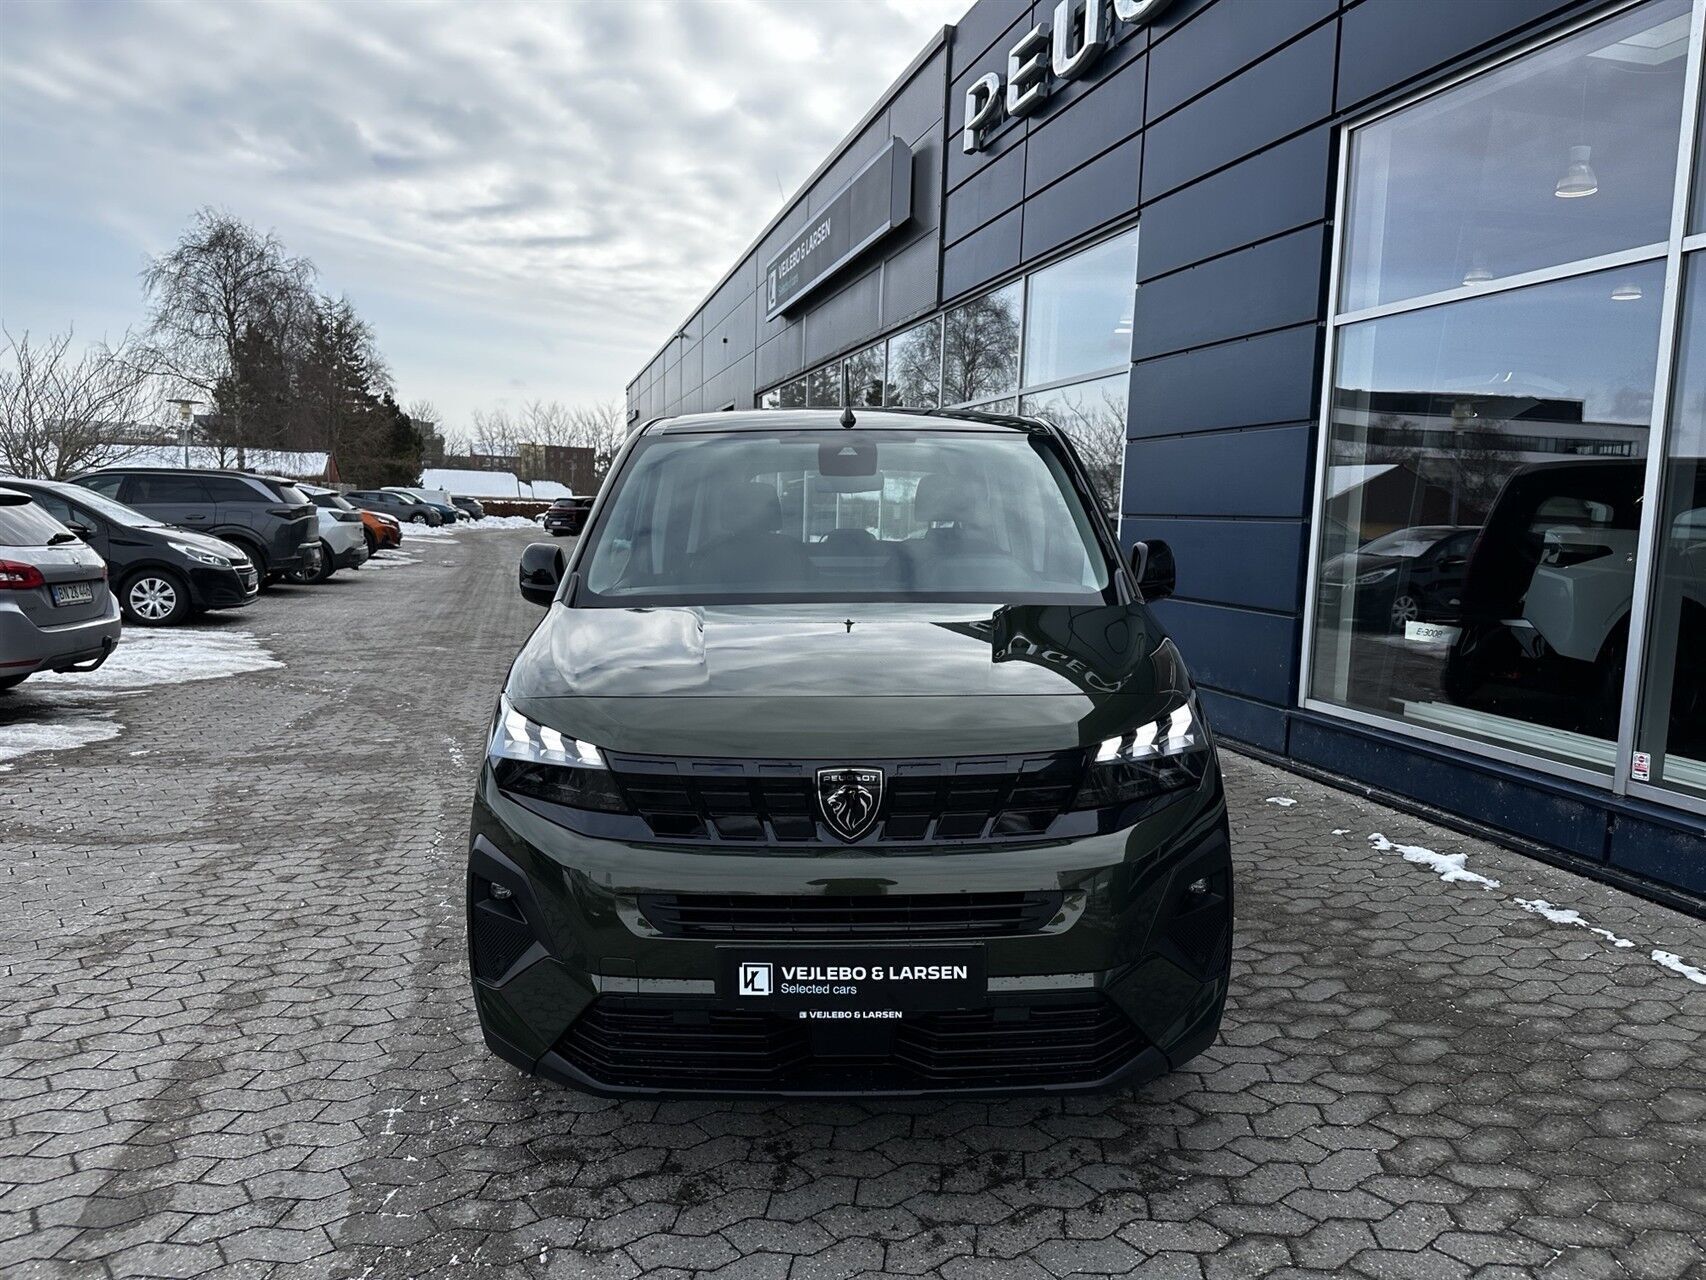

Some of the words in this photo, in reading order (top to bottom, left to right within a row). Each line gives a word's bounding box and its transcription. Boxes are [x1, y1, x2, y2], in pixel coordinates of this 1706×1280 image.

[806, 218, 831, 255] LARSEN
[58, 586, 70, 600] BN
[68, 585, 80, 599] 28
[781, 965, 867, 981] VEJLEBO
[871, 965, 885, 980] &
[889, 965, 968, 980] LARSEN
[780, 983, 830, 995] Selected
[832, 984, 857, 995] cars
[810, 1011, 852, 1019] VEJLEBO
[853, 1011, 861, 1019] &
[862, 1011, 903, 1019] LARSEN
